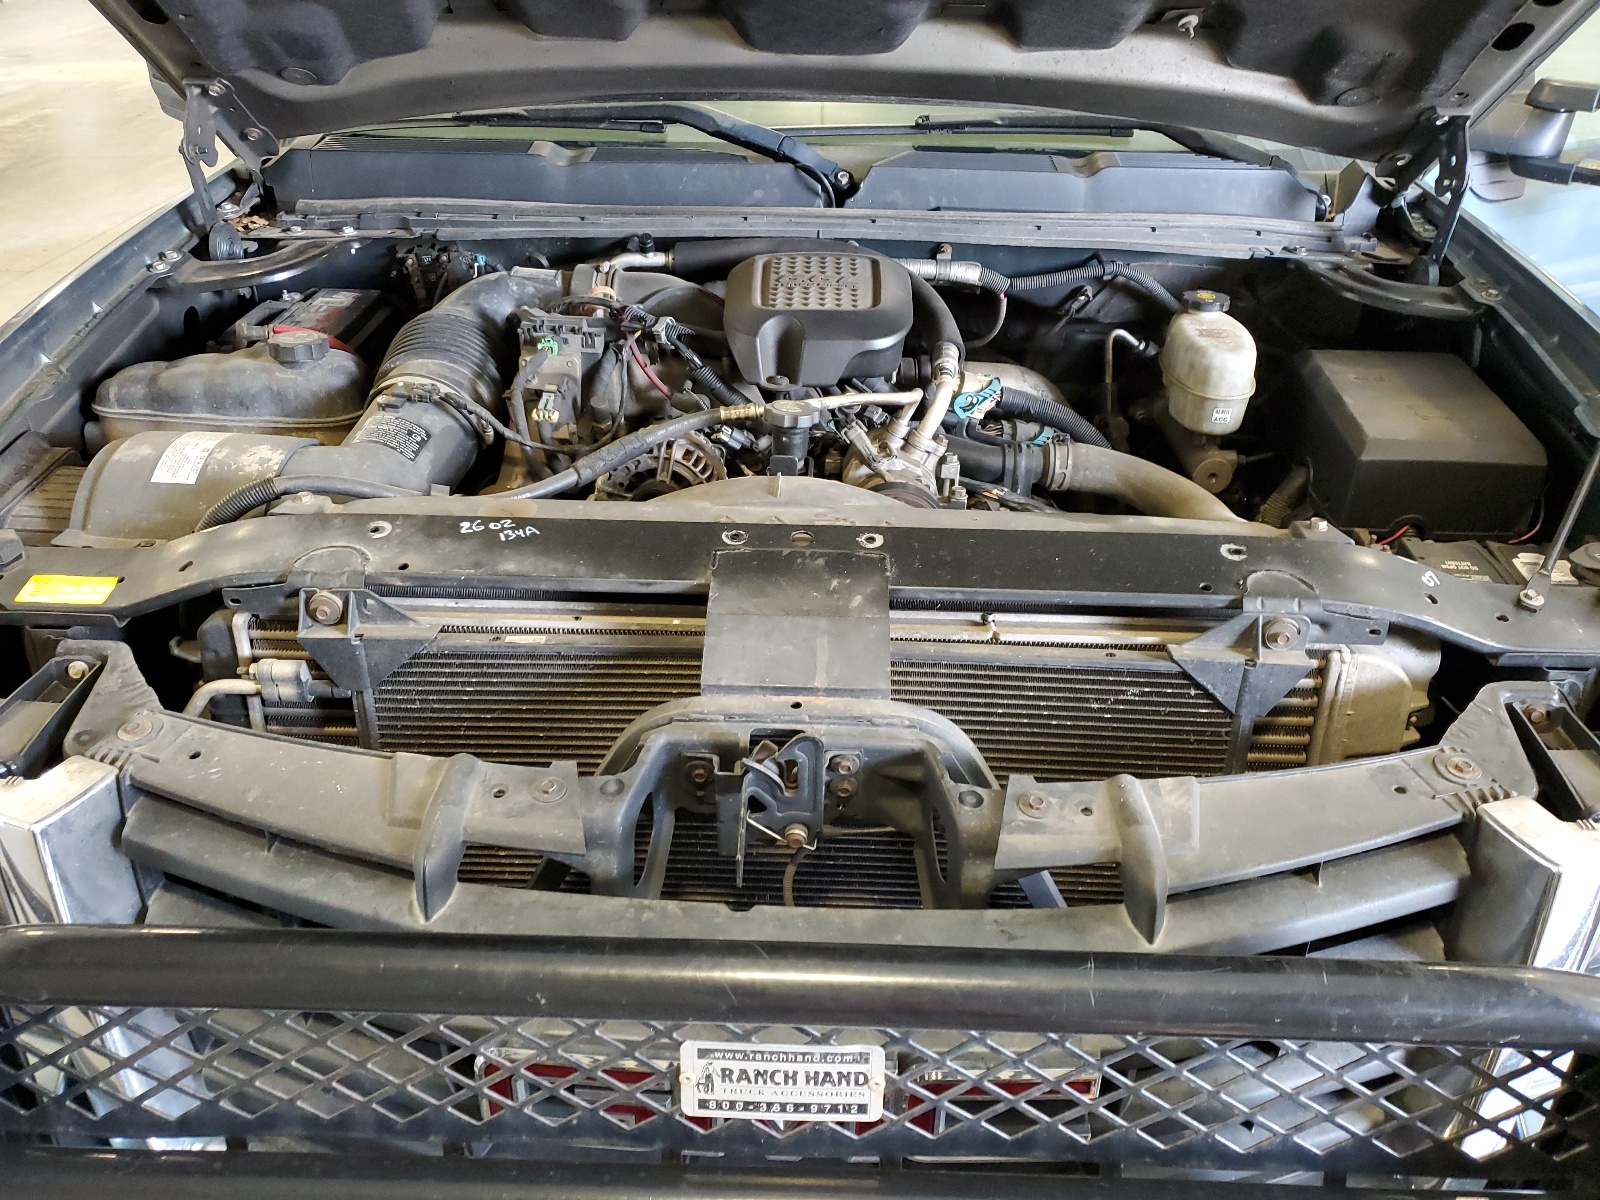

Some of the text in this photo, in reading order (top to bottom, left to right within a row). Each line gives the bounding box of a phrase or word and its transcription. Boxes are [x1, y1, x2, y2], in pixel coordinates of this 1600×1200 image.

[499, 526, 540, 541] 134A
[720, 1067, 869, 1087] RANCH HAND
[721, 1087, 866, 1098] TRUCK ACCESSORIES
